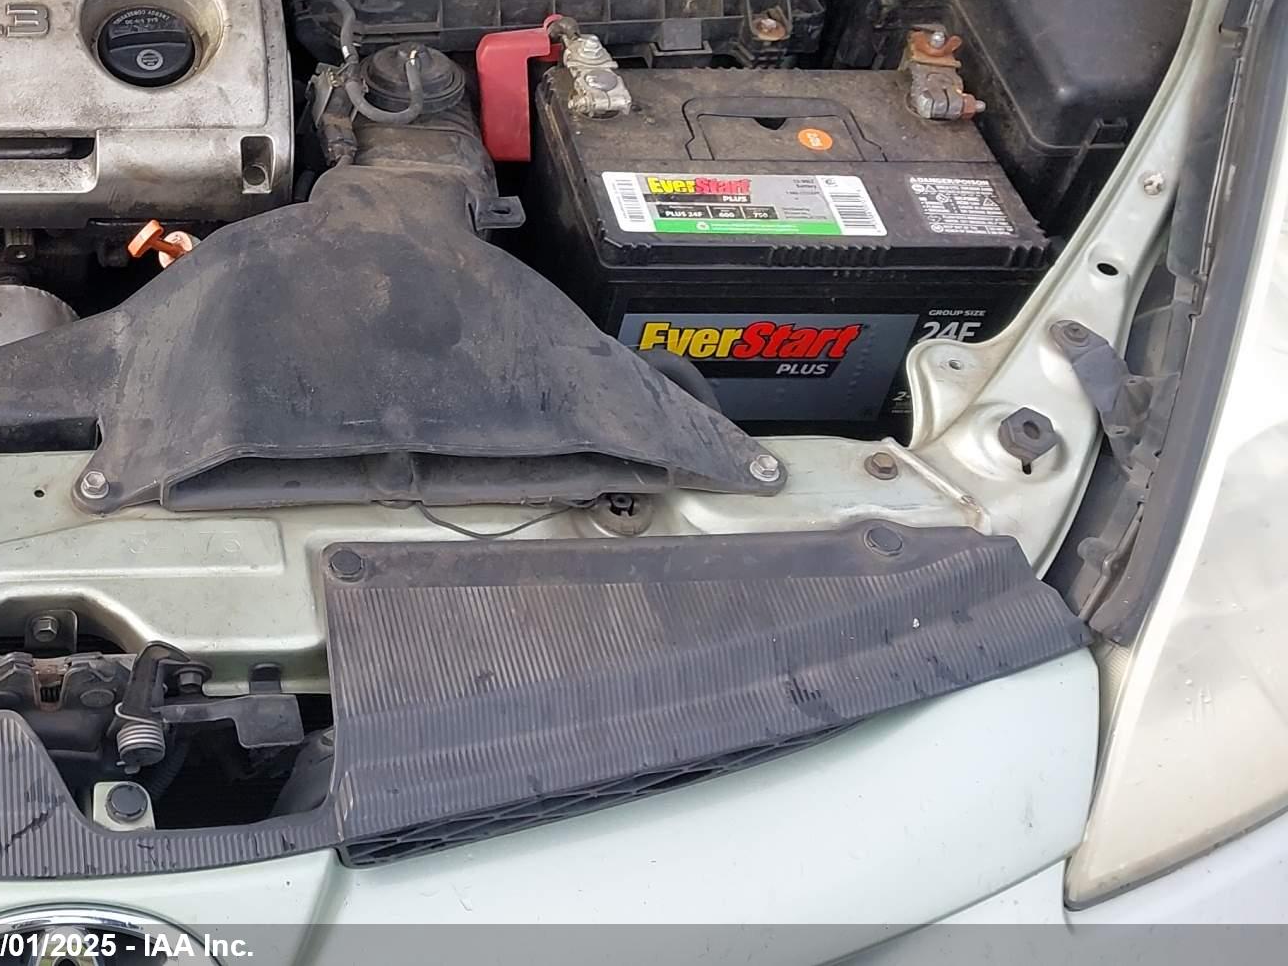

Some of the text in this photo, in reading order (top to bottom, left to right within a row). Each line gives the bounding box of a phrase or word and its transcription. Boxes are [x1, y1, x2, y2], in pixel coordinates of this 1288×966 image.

[646, 177, 752, 195] EverStart
[722, 195, 748, 203] PLUS
[665, 210, 688, 218] PLUS
[928, 309, 986, 317] GROUP SIZE
[917, 321, 982, 343] 24F
[640, 320, 864, 359] EverStart
[776, 363, 830, 375] PLUS
